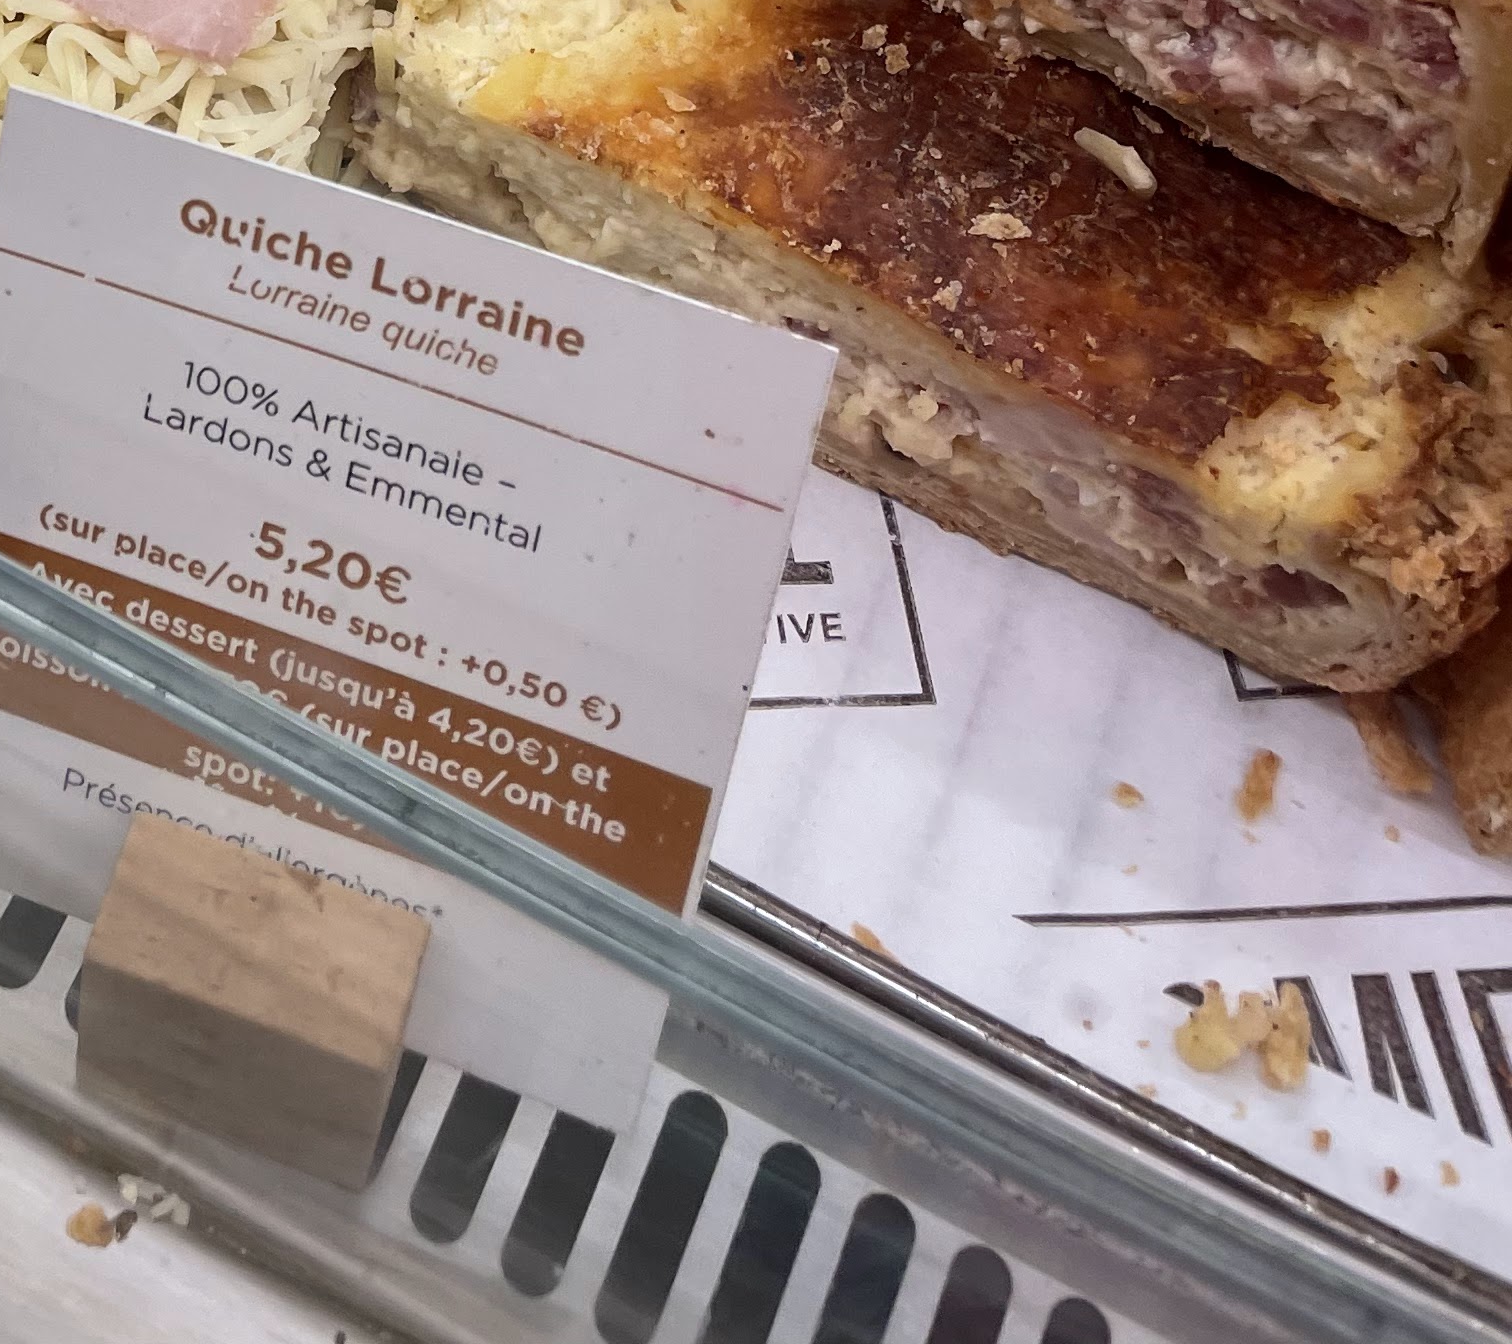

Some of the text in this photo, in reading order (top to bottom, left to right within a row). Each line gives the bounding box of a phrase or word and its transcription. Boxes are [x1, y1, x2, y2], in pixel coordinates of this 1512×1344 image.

[179, 198, 586, 358] Quiche Lorraine
[228, 265, 499, 377] Lorraine quiche
[184, 361, 280, 417] 100%
[143, 393, 542, 553] Lardons & Emmental
[39, 504, 622, 731] (sur place/on the spot : +0,50 €)
[254, 521, 412, 605] 5,20€
[31, 561, 611, 793] Avec dessert (jusqu'à 4,20€) et
[184, 745, 276, 795] spot:
[381, 734, 552, 816] place/on
[562, 802, 626, 843] the
